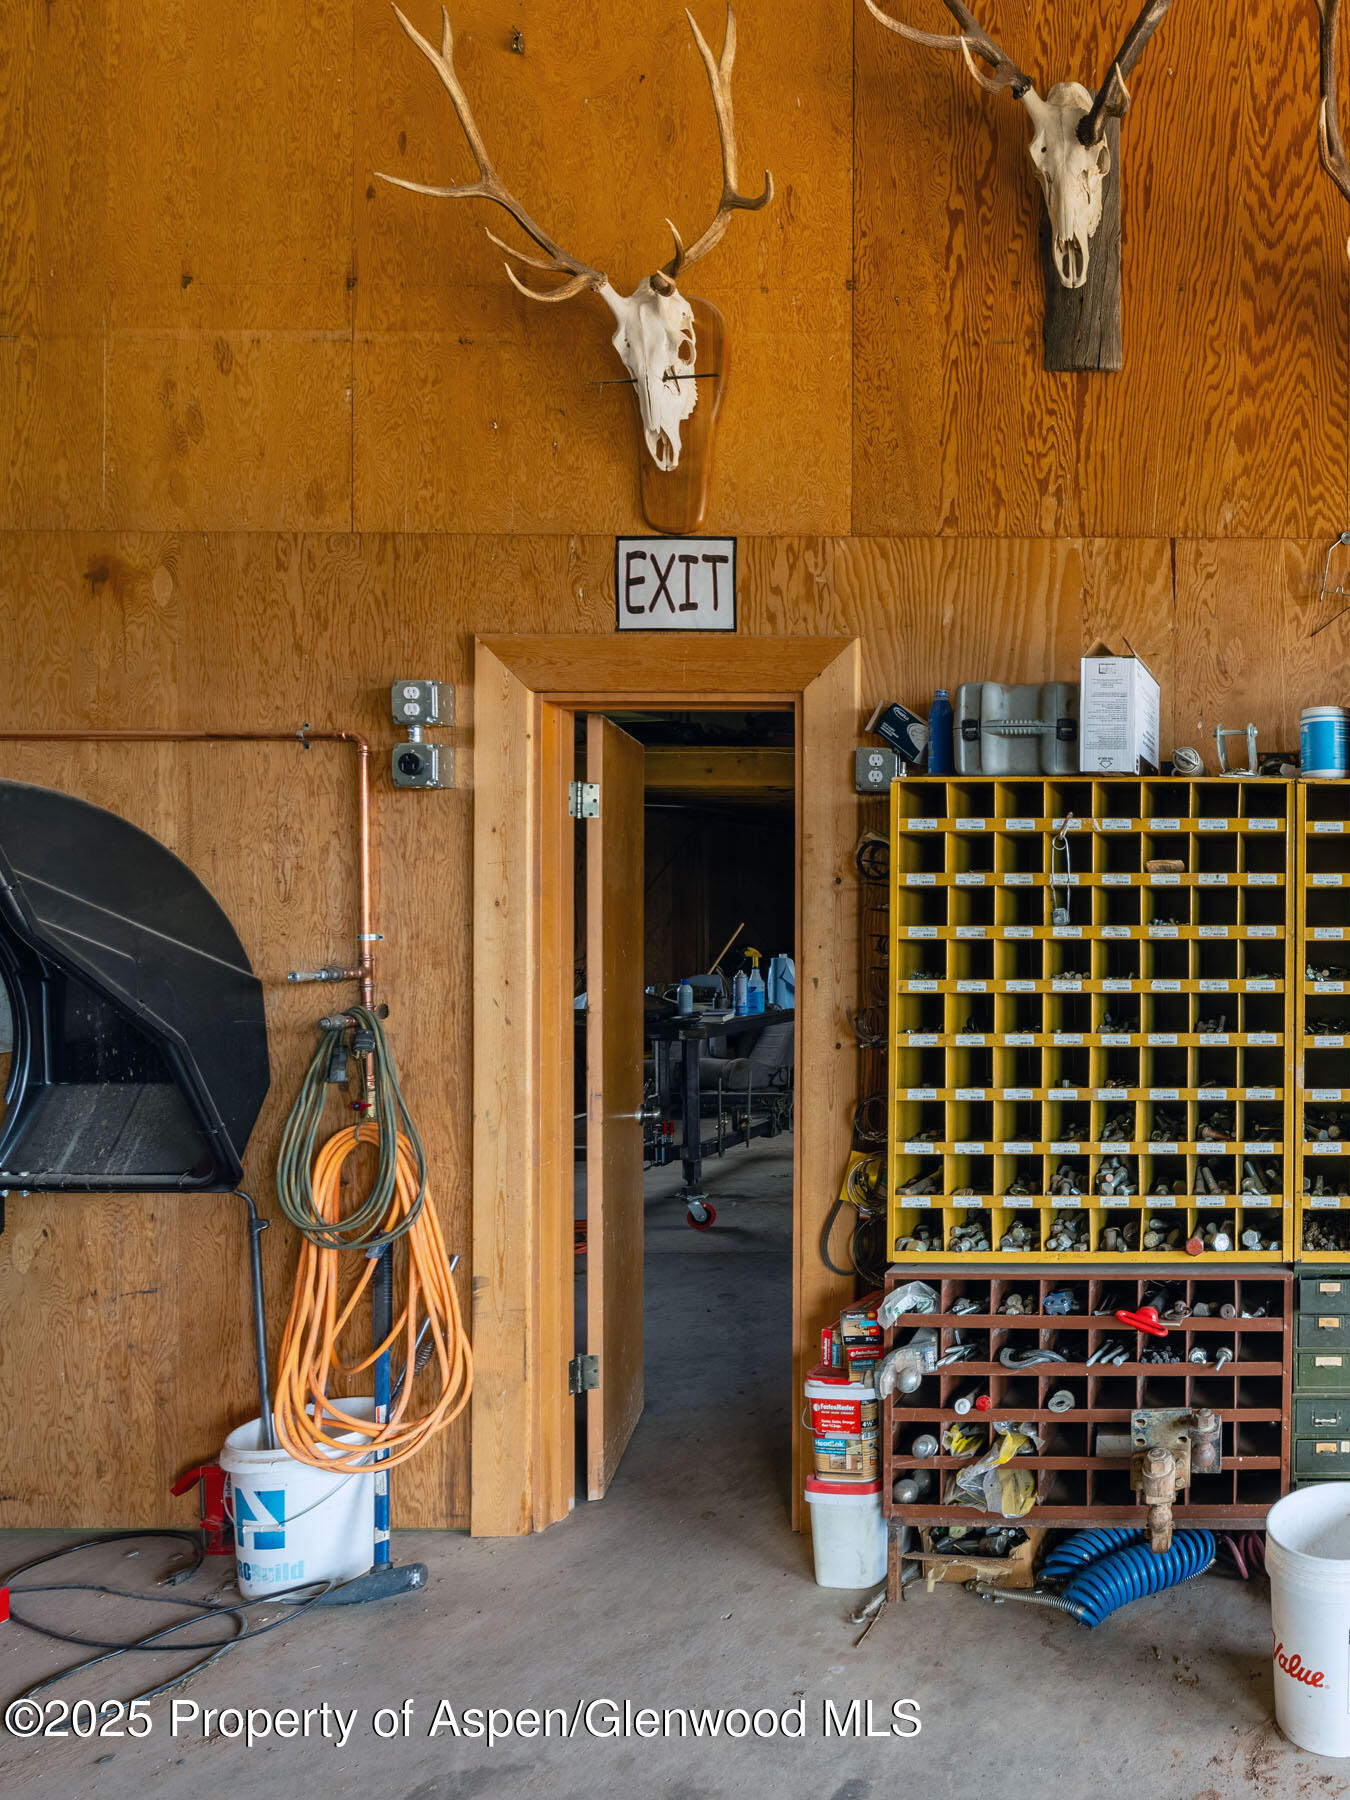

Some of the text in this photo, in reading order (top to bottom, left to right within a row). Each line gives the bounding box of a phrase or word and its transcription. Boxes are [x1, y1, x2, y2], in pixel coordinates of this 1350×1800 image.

[625, 550, 729, 614] EXIT
[820, 1403, 855, 1411] FastenMaster
[1272, 1632, 1324, 1688] Value
